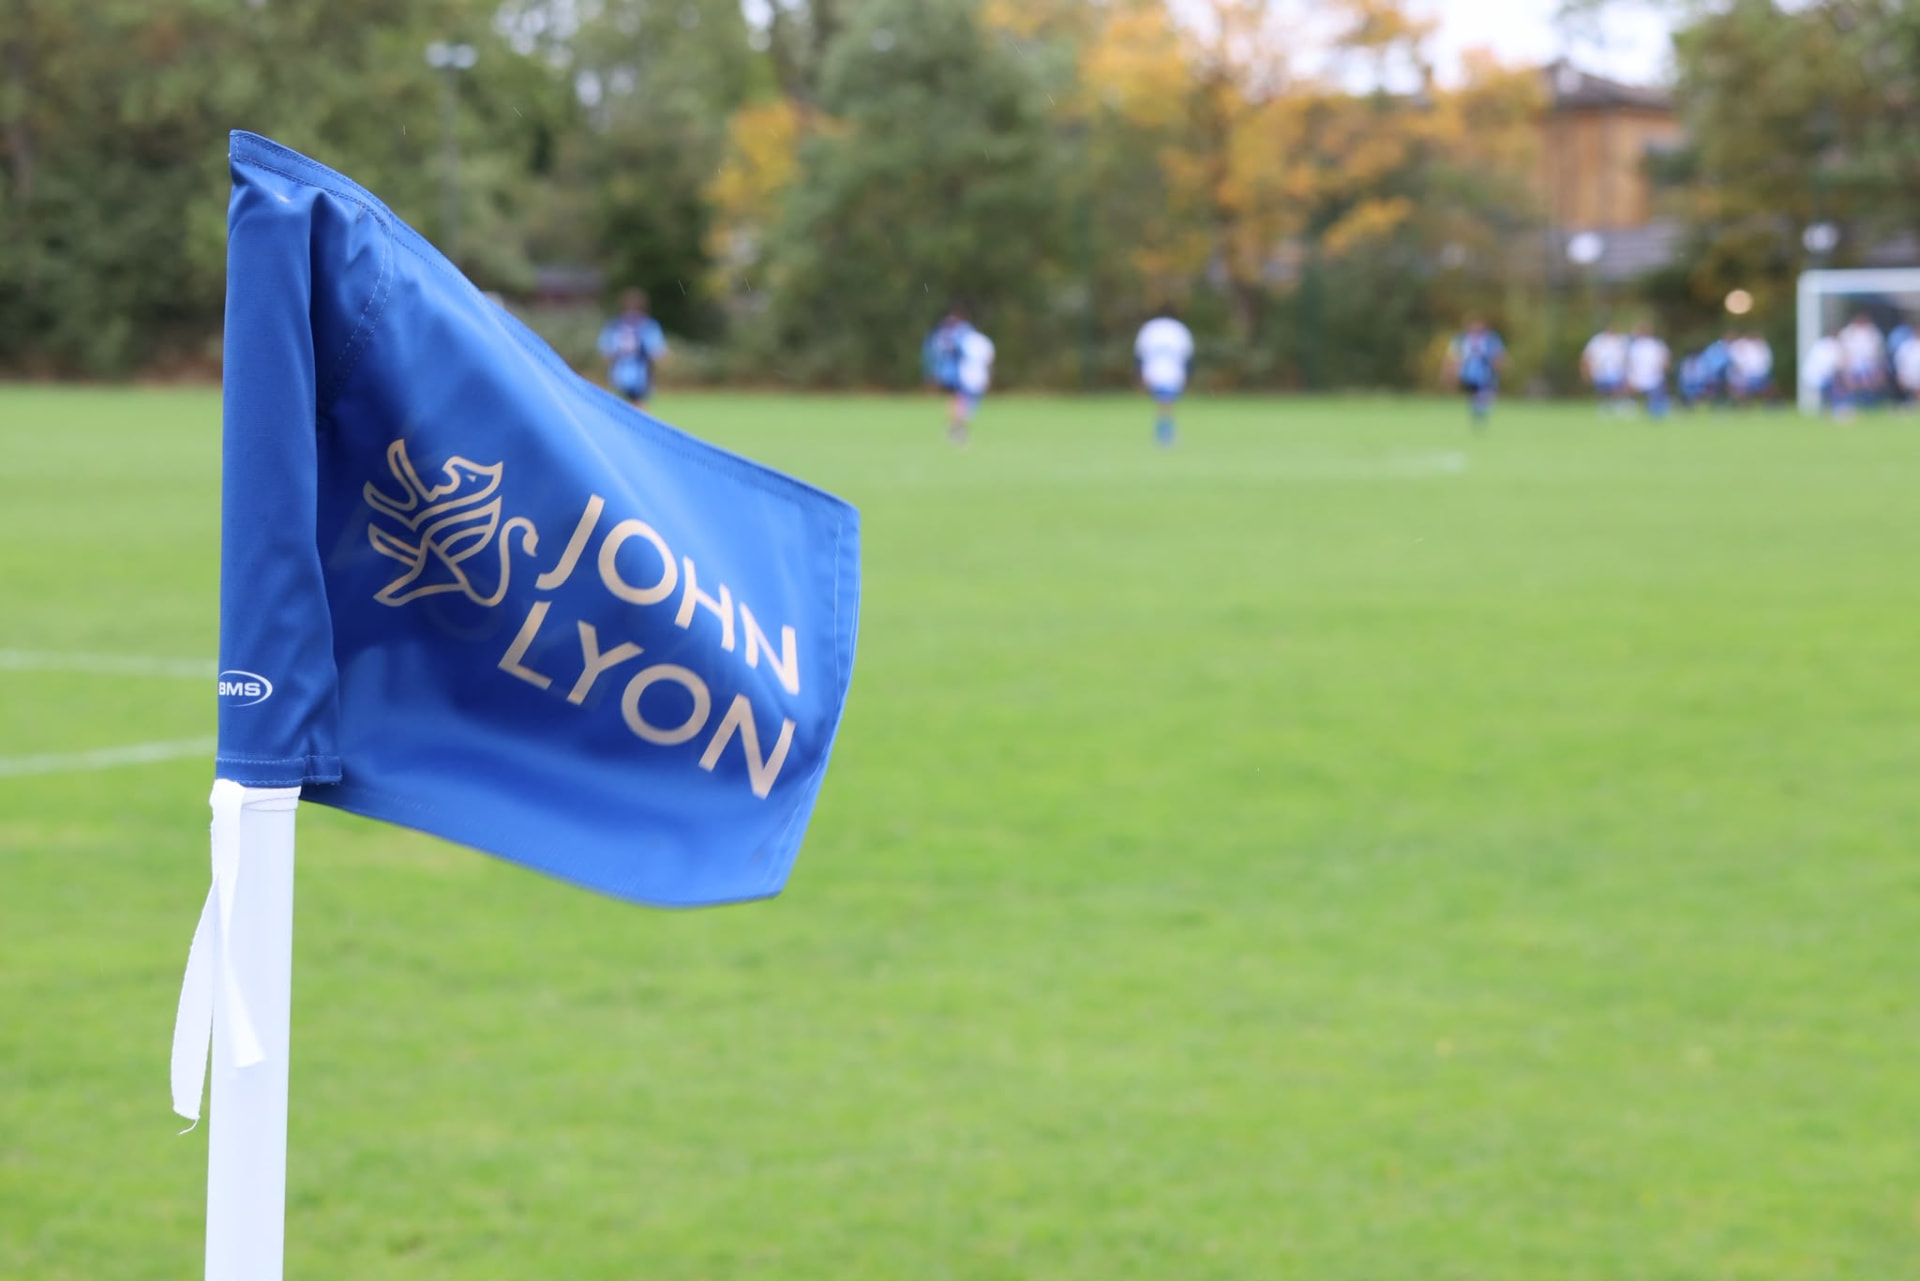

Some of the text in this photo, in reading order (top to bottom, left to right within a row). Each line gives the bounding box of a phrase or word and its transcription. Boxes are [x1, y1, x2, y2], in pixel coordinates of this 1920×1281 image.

[218, 681, 261, 697] BMS
[535, 494, 799, 695] JOHN
[498, 601, 796, 800] LYON
